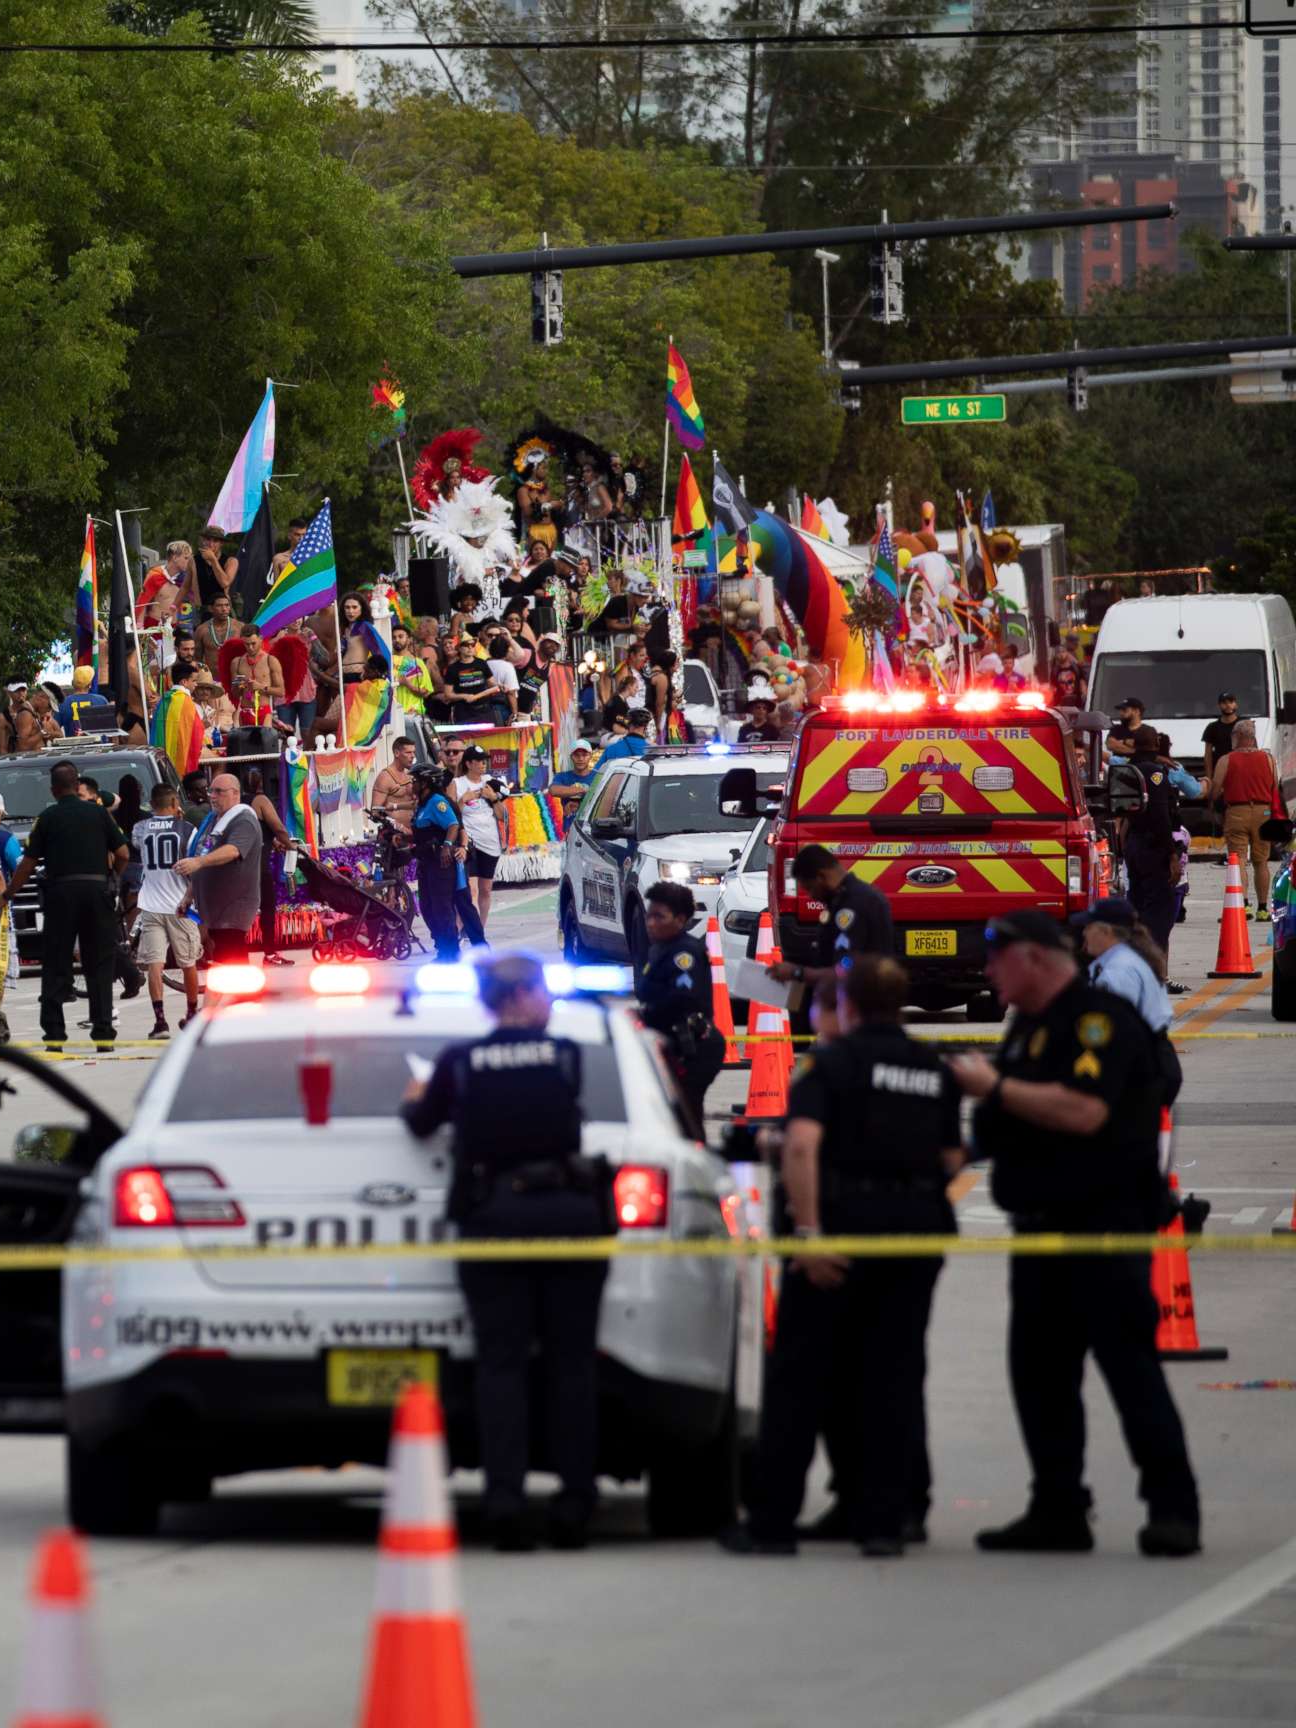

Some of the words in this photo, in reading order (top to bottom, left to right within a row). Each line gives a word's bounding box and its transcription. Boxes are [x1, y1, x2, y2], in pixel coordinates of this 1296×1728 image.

[925, 402, 941, 417] NE
[947, 402, 960, 417] 16
[966, 400, 981, 416] ST
[835, 730, 879, 742] FORT
[881, 728, 989, 742] LAUDERDALE
[993, 728, 1031, 740] FIRE
[899, 763, 963, 774] DIVISION
[918, 746, 944, 785] 2
[144, 832, 180, 870] 10
[869, 842, 893, 854] LIFE
[914, 937, 949, 950] XF6419
[470, 1042, 555, 1070] POLICE
[872, 1062, 941, 1098] POLICE
